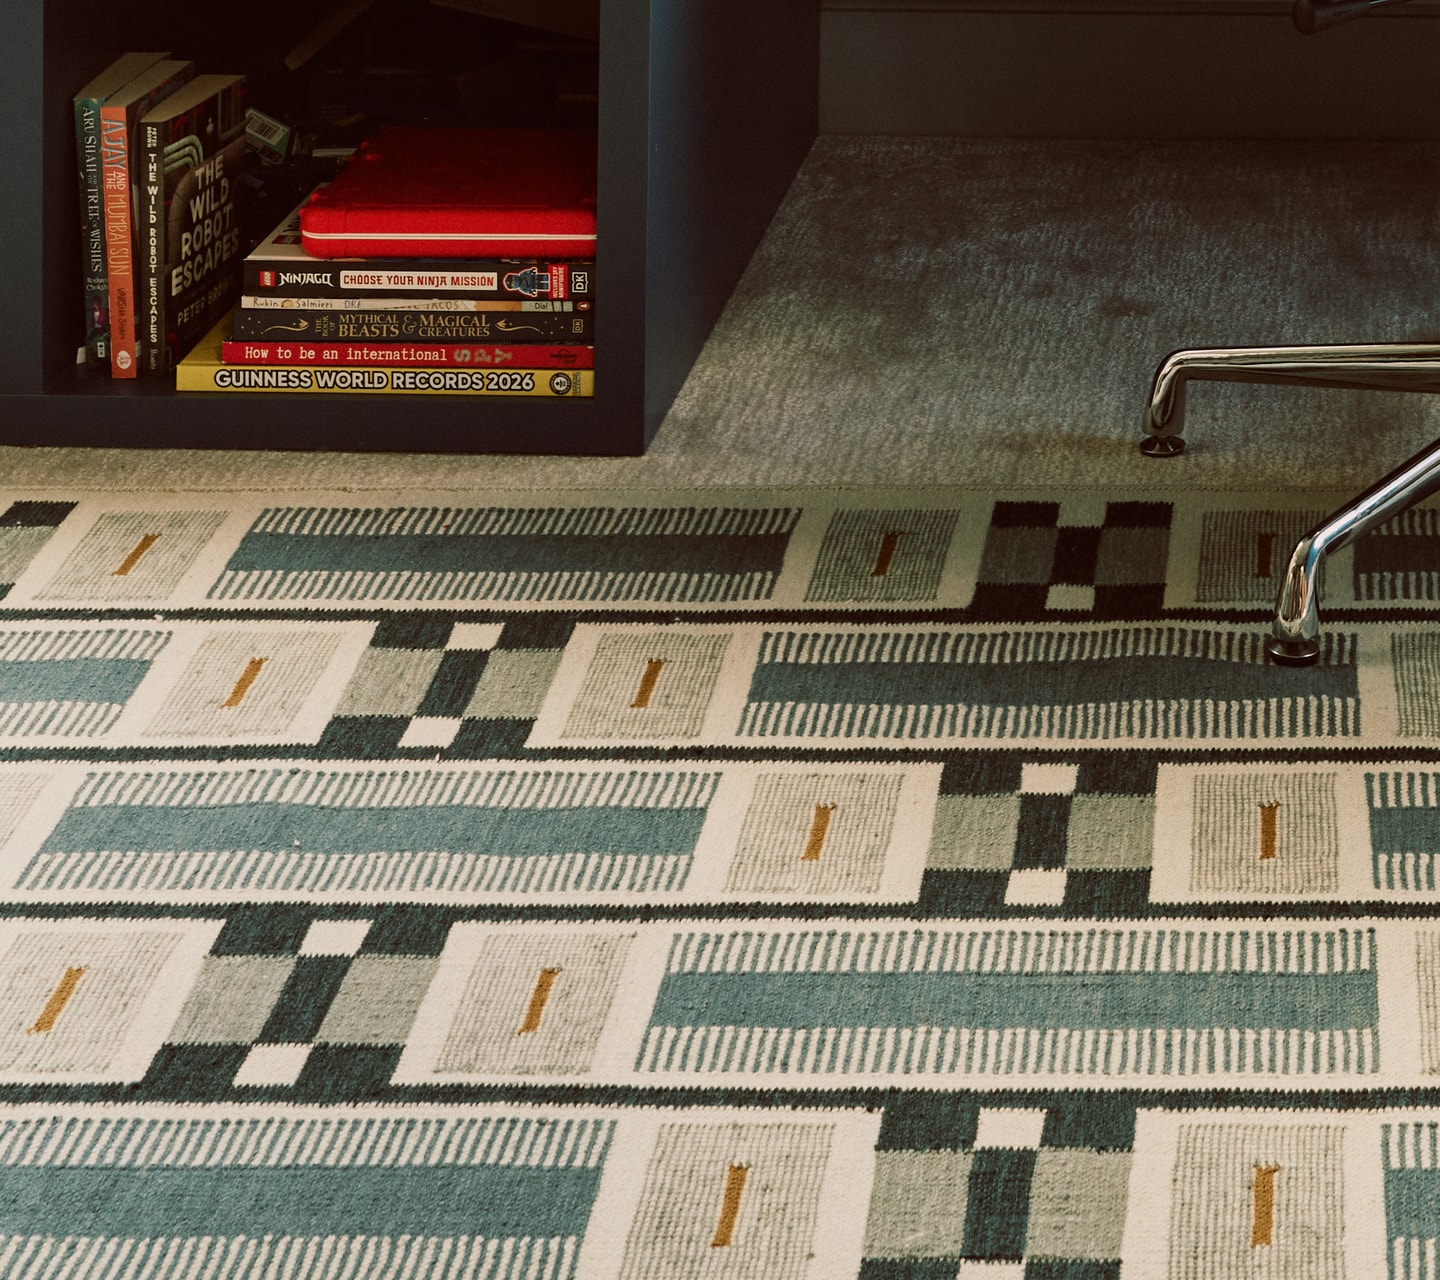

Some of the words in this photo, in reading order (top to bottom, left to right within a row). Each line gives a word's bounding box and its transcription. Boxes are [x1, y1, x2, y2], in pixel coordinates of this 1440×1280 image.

[82, 106, 96, 133] ARU
[84, 135, 98, 172] SHAH
[102, 119, 127, 171] AJAY
[106, 170, 117, 190] THE
[116, 172, 127, 191] AND
[148, 153, 158, 182] THE
[195, 154, 225, 190] THE
[147, 185, 159, 224] WILD
[190, 177, 229, 223] WILD
[107, 194, 129, 245] MUMBAI
[181, 202, 233, 260] ROBOT
[109, 247, 130, 275] SUN
[149, 227, 158, 274] ROBOT
[171, 227, 240, 297] ESCAPES
[343, 275, 383, 285] CHOOSE
[386, 275, 414, 286] YOUR
[417, 276, 448, 288] NINJA
[450, 276, 495, 287] MISSION
[149, 277, 158, 343] ESCAPES
[339, 314, 399, 324] MYTHICAL
[419, 314, 491, 327] MAGICAL
[338, 324, 400, 337] BEASTS
[418, 326, 491, 337] CREATURES
[245, 346, 269, 359] How
[276, 347, 292, 359] to
[299, 346, 316, 359] be
[322, 349, 339, 360] an
[346, 347, 448, 362] international
[214, 370, 312, 388] GUINNESS
[312, 370, 389, 390] WORLD
[391, 371, 486, 391] RECORDS
[486, 371, 535, 391] 2026
